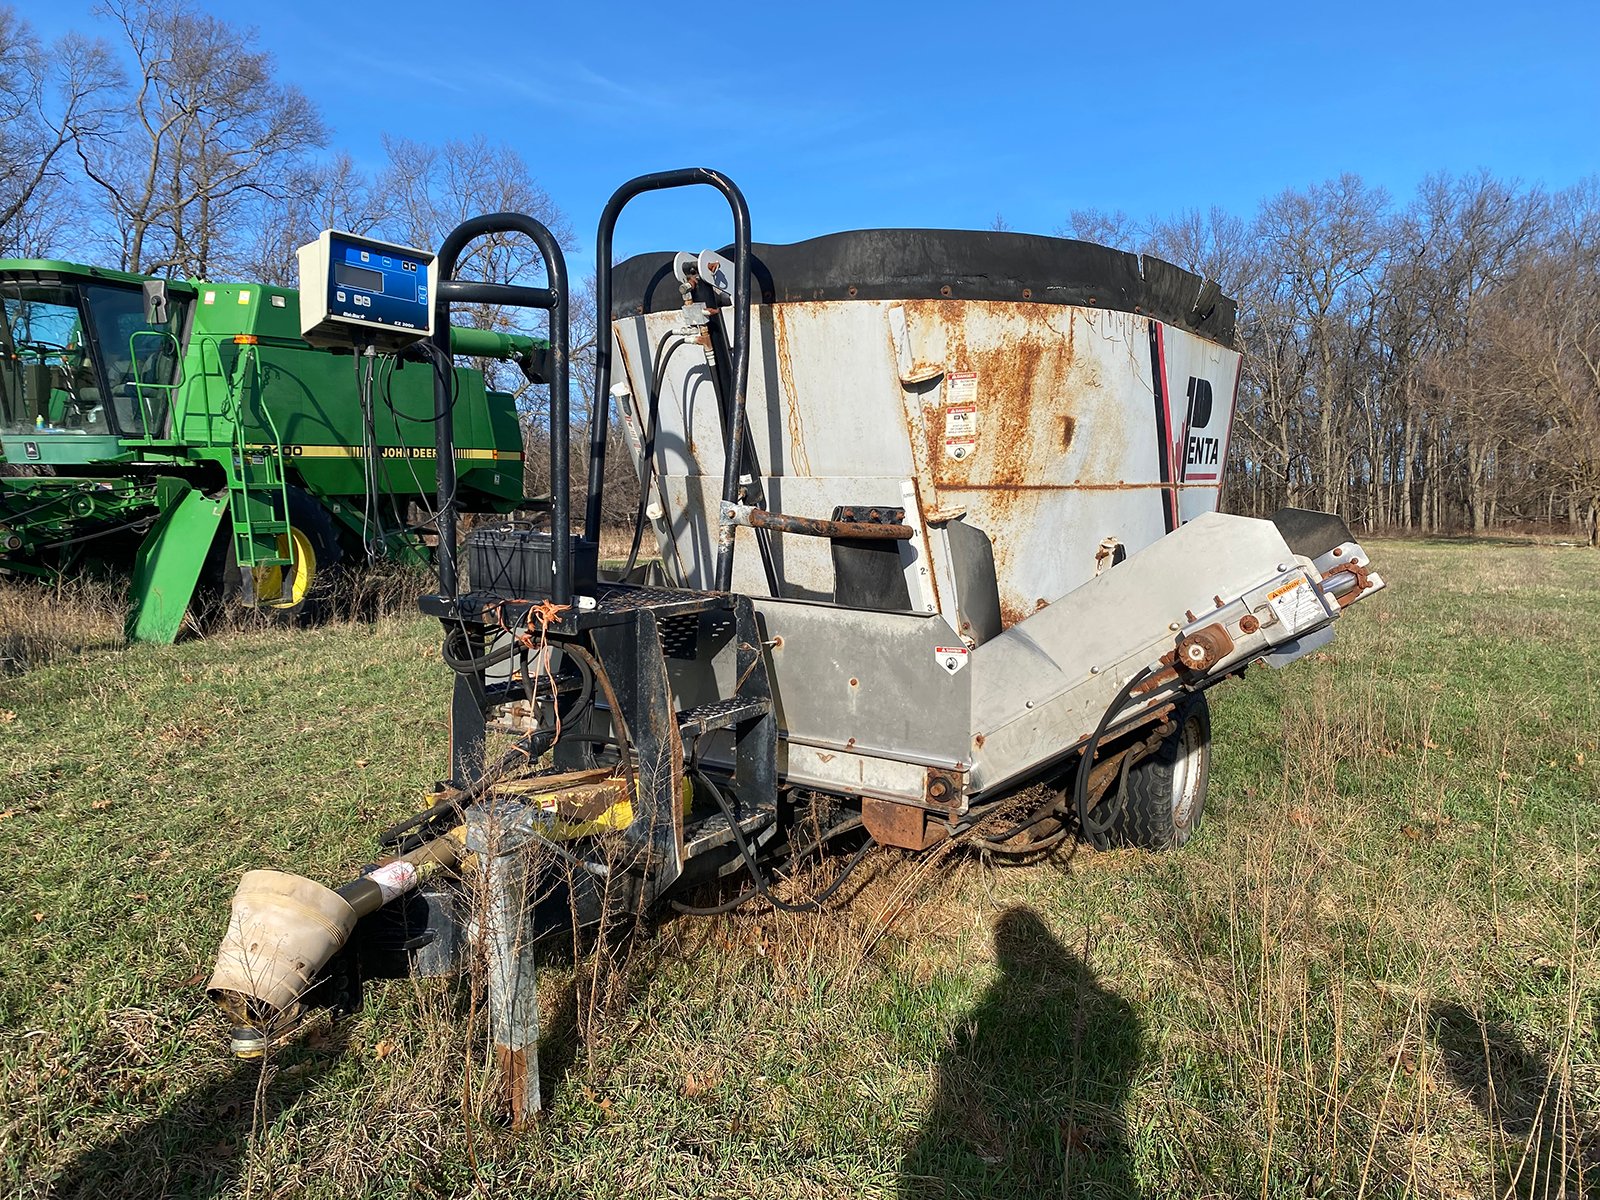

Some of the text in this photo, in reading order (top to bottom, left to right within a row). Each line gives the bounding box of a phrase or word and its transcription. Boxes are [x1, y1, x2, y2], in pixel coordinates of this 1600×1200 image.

[1179, 376, 1219, 484] PENTA
[382, 447, 410, 458] JOHN
[412, 447, 437, 458] DEER
[1277, 578, 1301, 595] WARNIN
